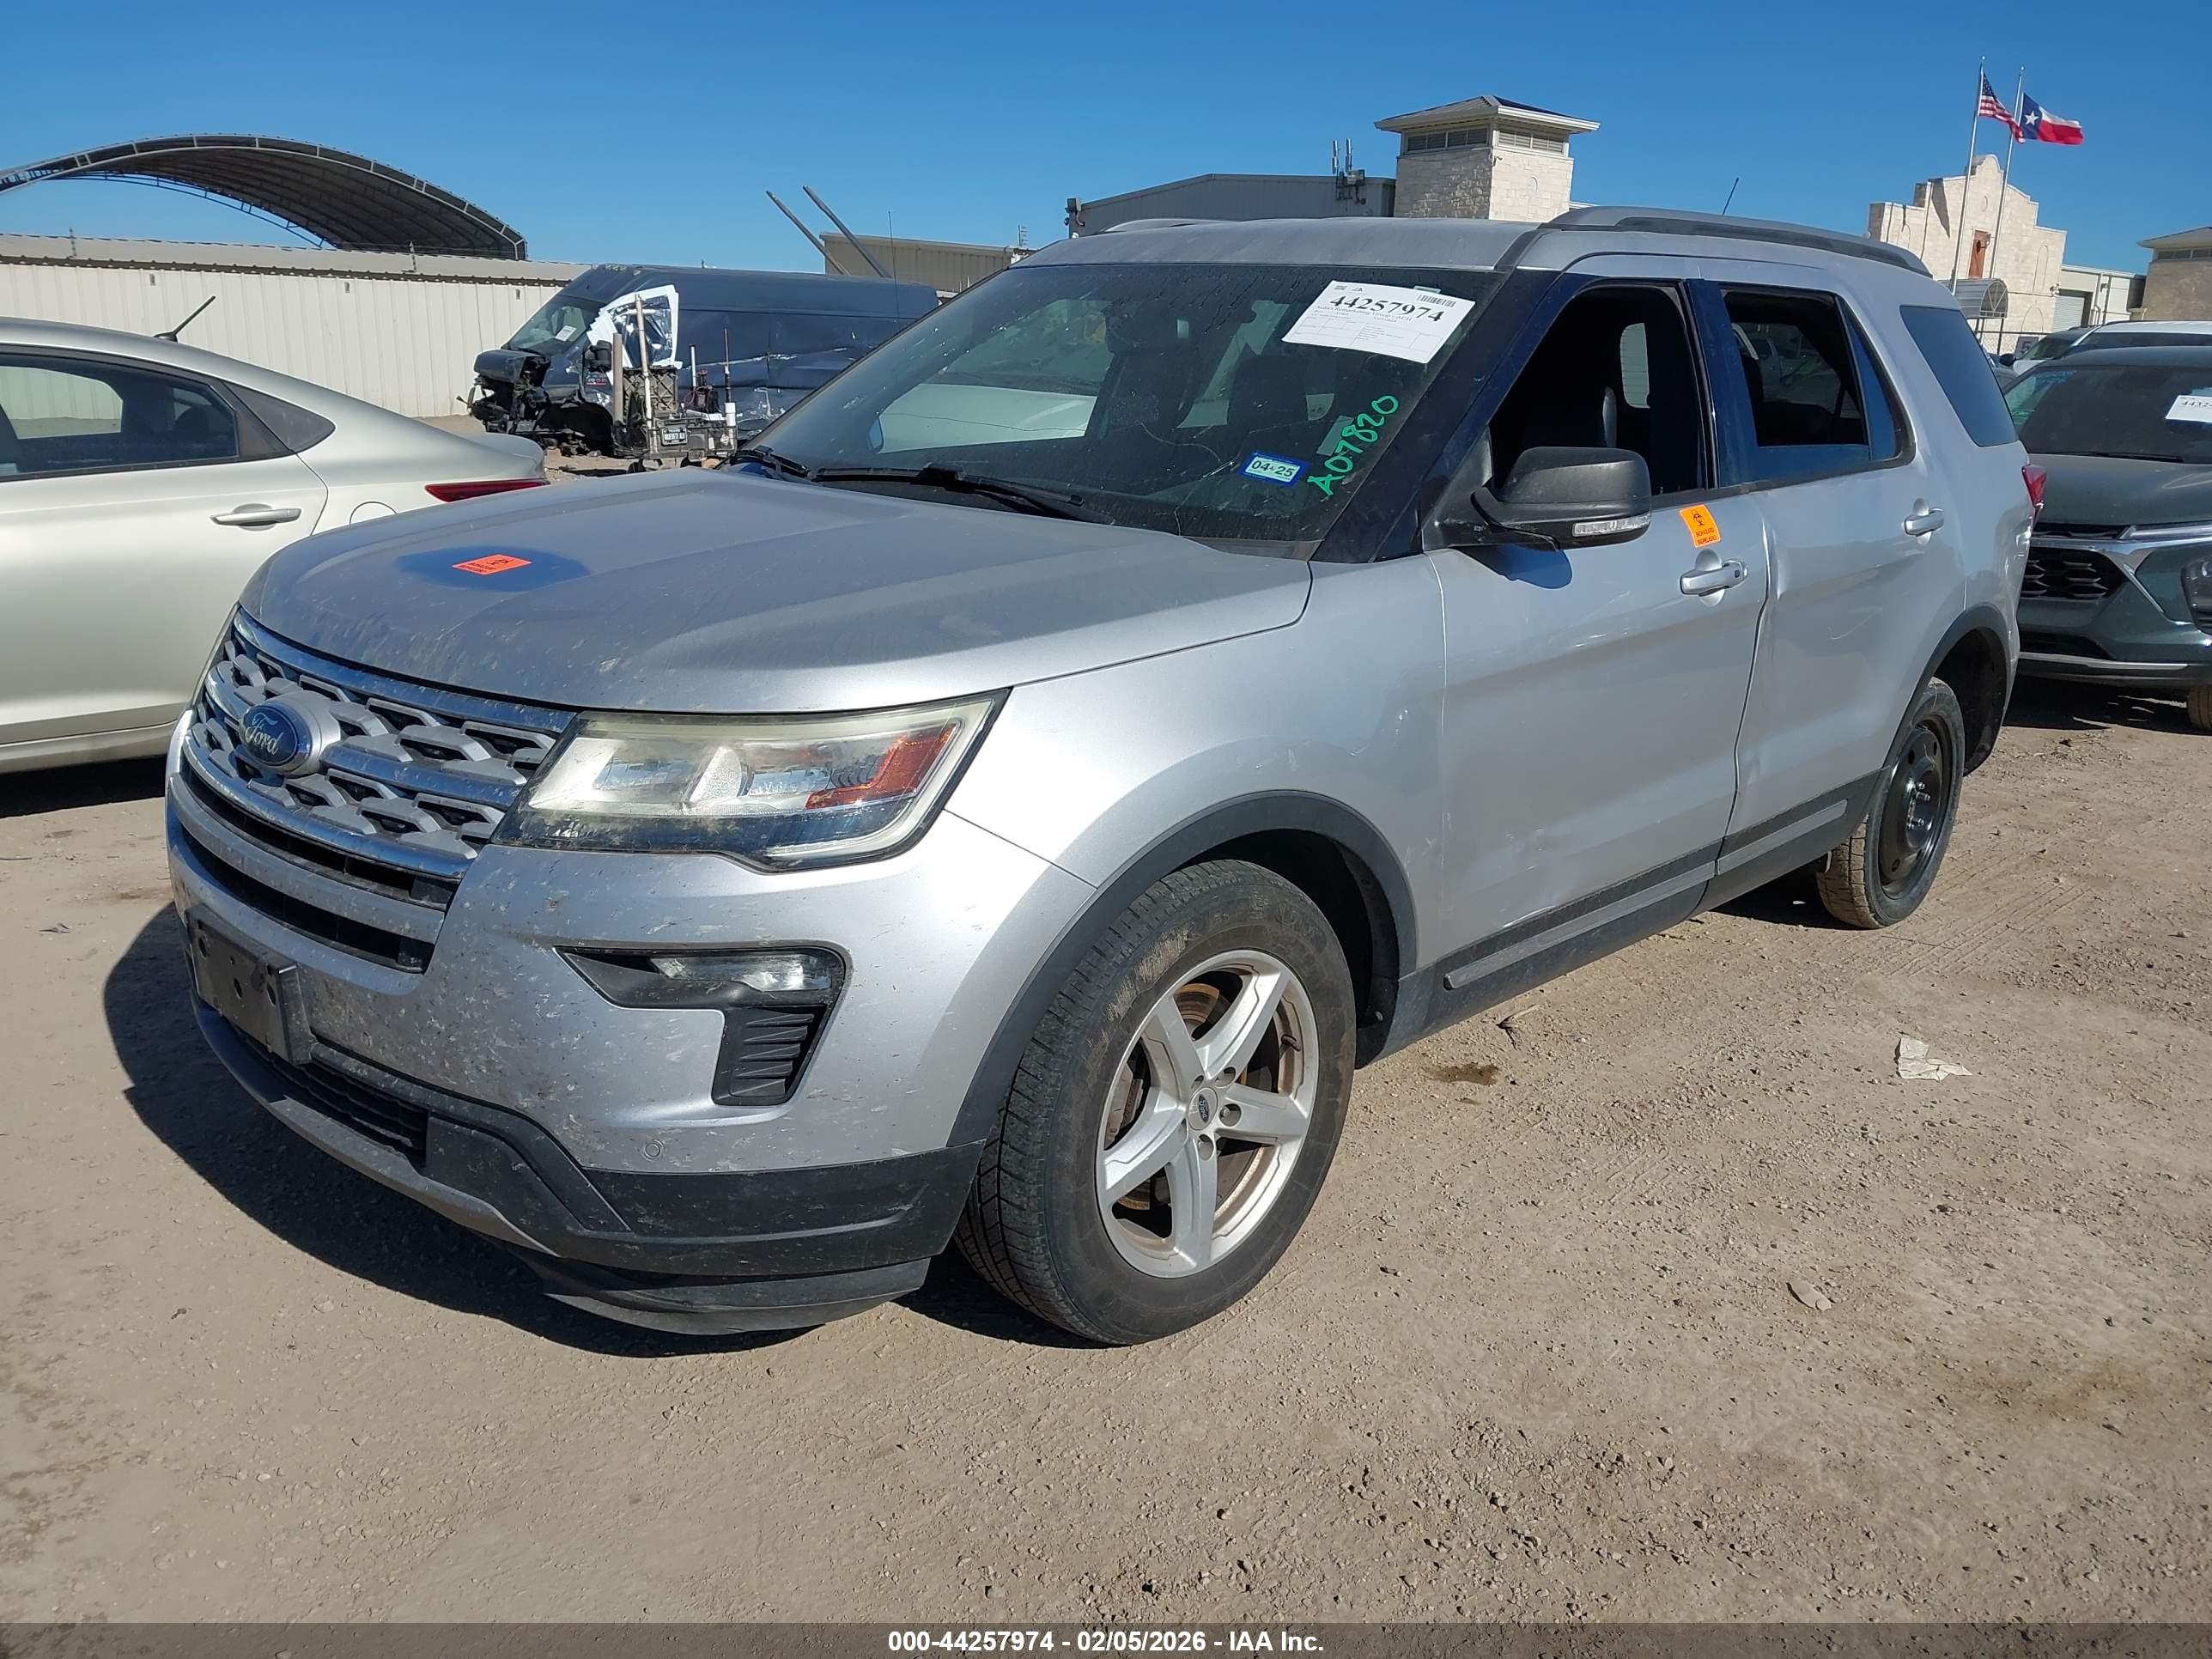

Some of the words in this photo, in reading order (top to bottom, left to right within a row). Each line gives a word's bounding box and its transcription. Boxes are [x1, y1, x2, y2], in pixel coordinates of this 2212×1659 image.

[1330, 295, 1444, 322] 44257974
[1307, 395, 1400, 495] A07820
[246, 712, 284, 755] Ford
